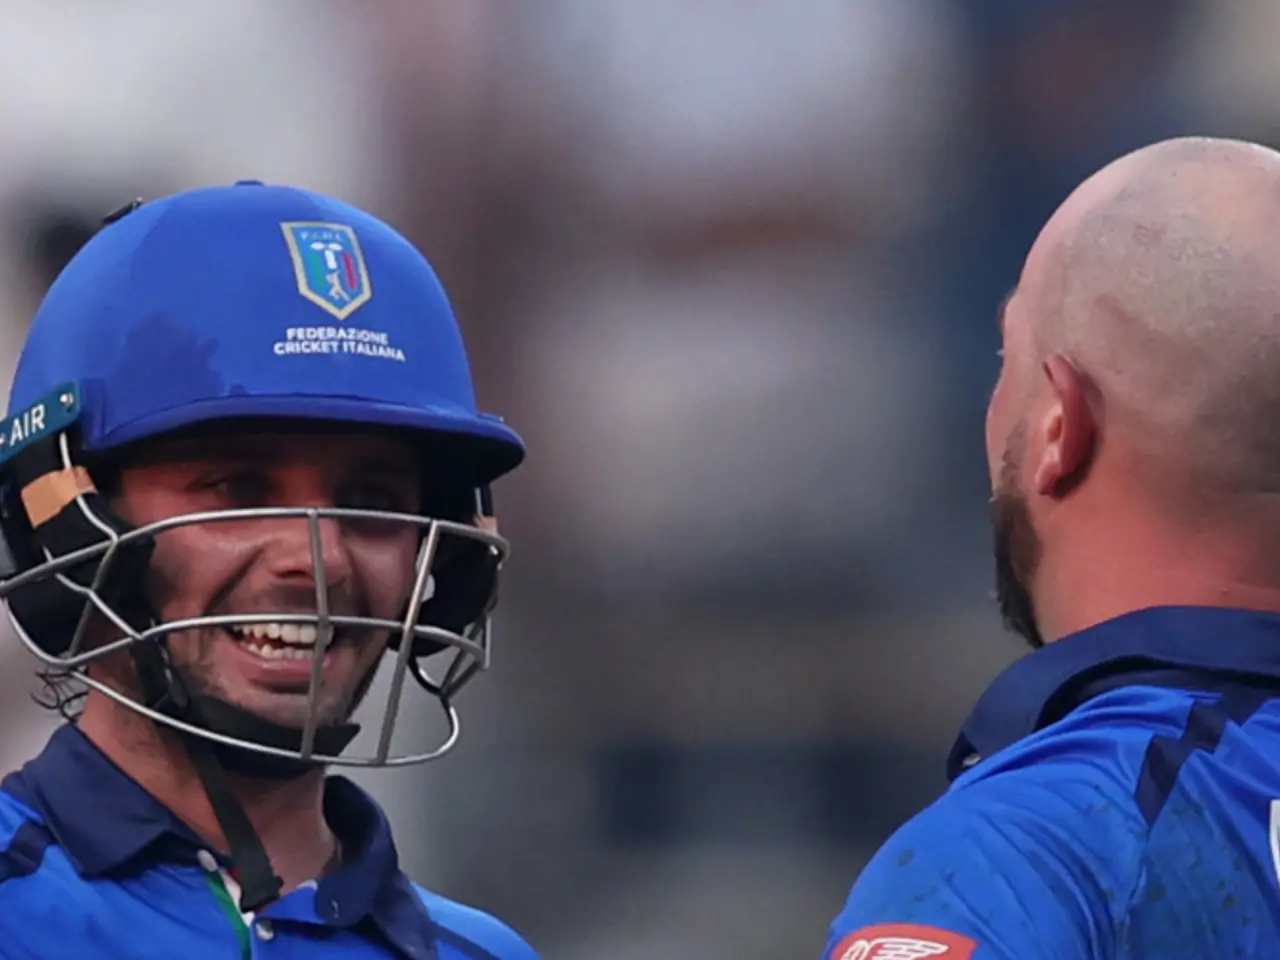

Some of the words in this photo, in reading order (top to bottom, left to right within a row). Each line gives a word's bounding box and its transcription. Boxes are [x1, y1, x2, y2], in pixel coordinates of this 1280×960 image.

[286, 327, 388, 345] FEDERAZIONE
[274, 341, 338, 355] CRICKET
[343, 341, 405, 362] ITALIANA
[10, 403, 45, 447] AIR
